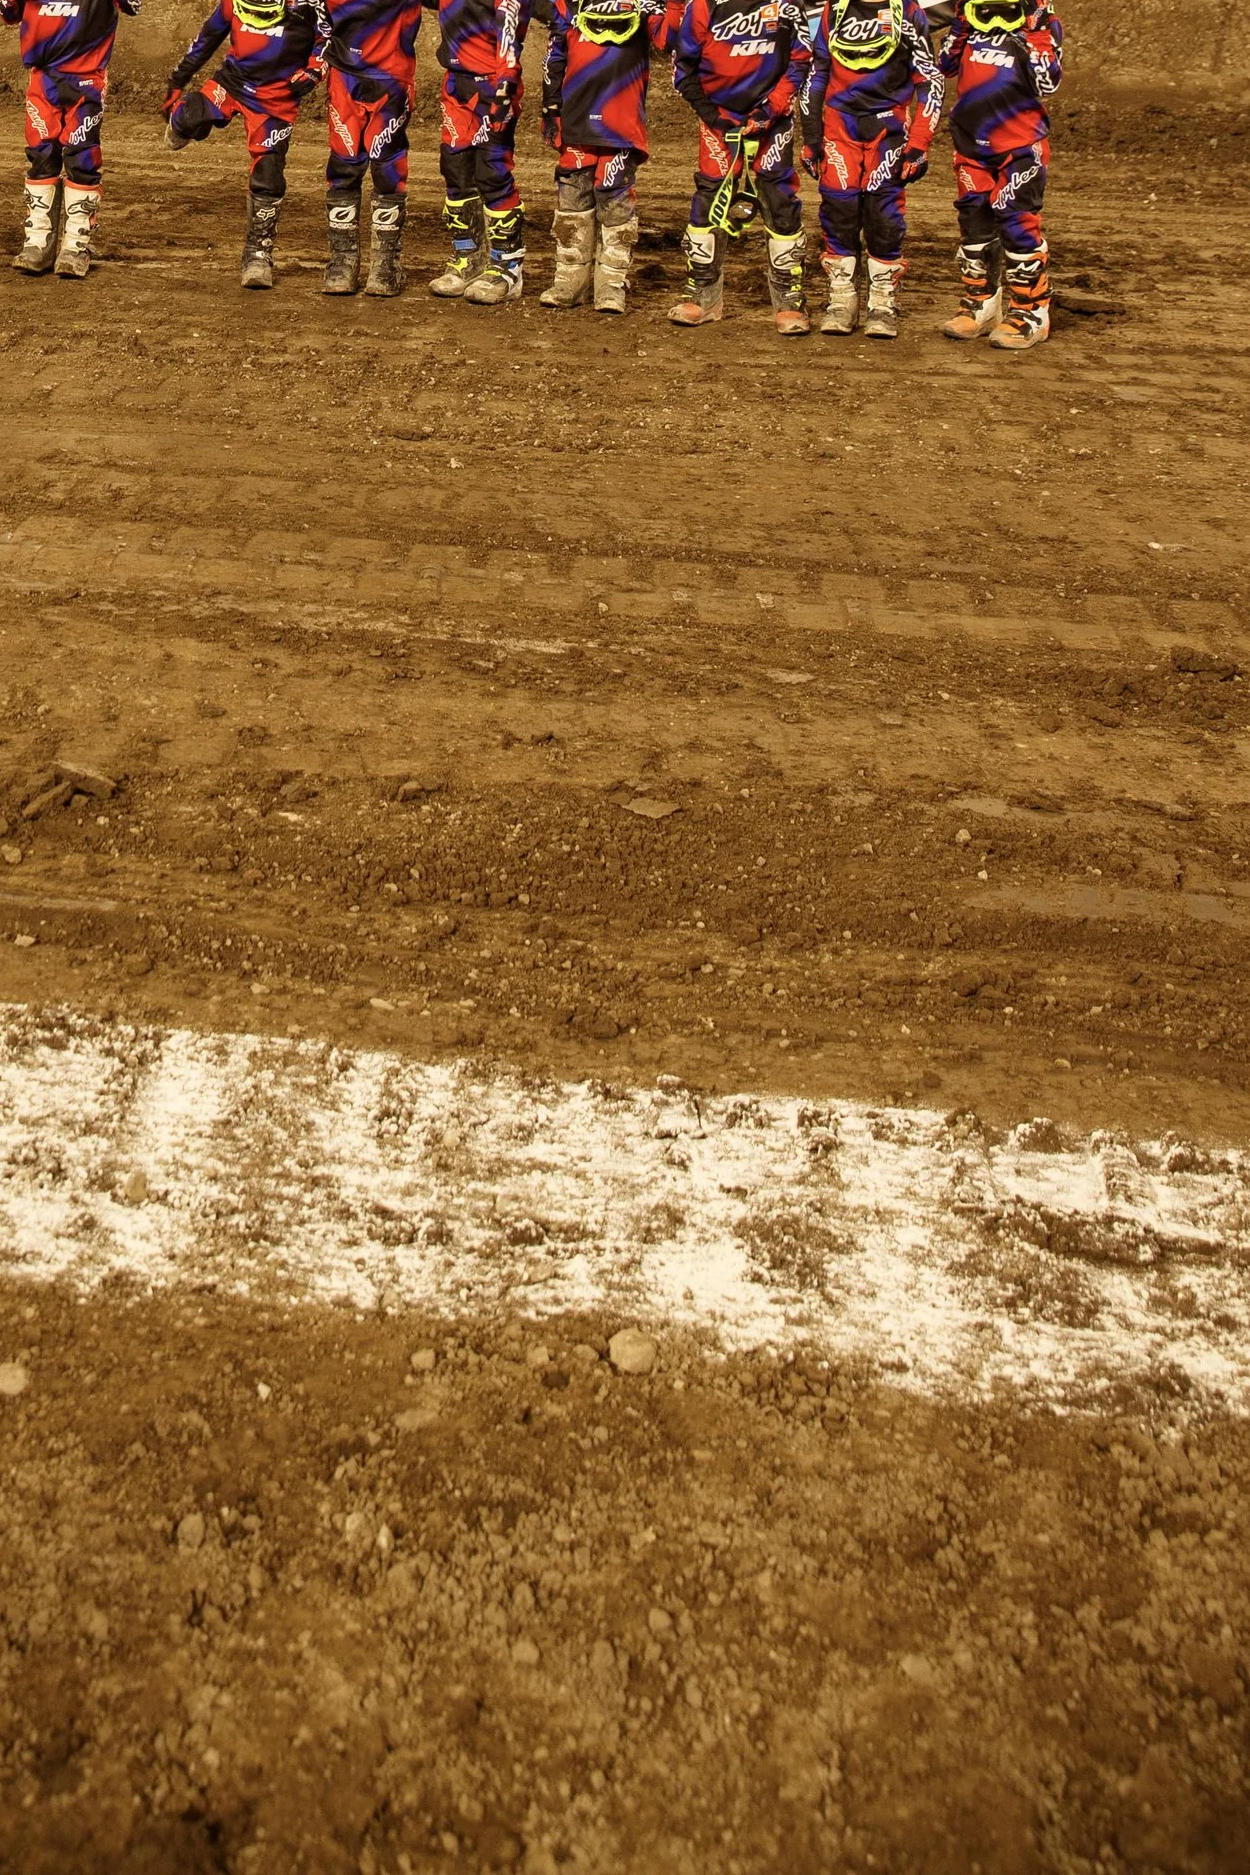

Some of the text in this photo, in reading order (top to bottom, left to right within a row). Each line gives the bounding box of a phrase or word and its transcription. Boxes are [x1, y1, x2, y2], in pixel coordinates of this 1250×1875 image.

[38, 1, 80, 17] KTM
[730, 38, 776, 58] KTM
[969, 49, 1016, 69] KTM
[709, 177, 734, 227] 100%
